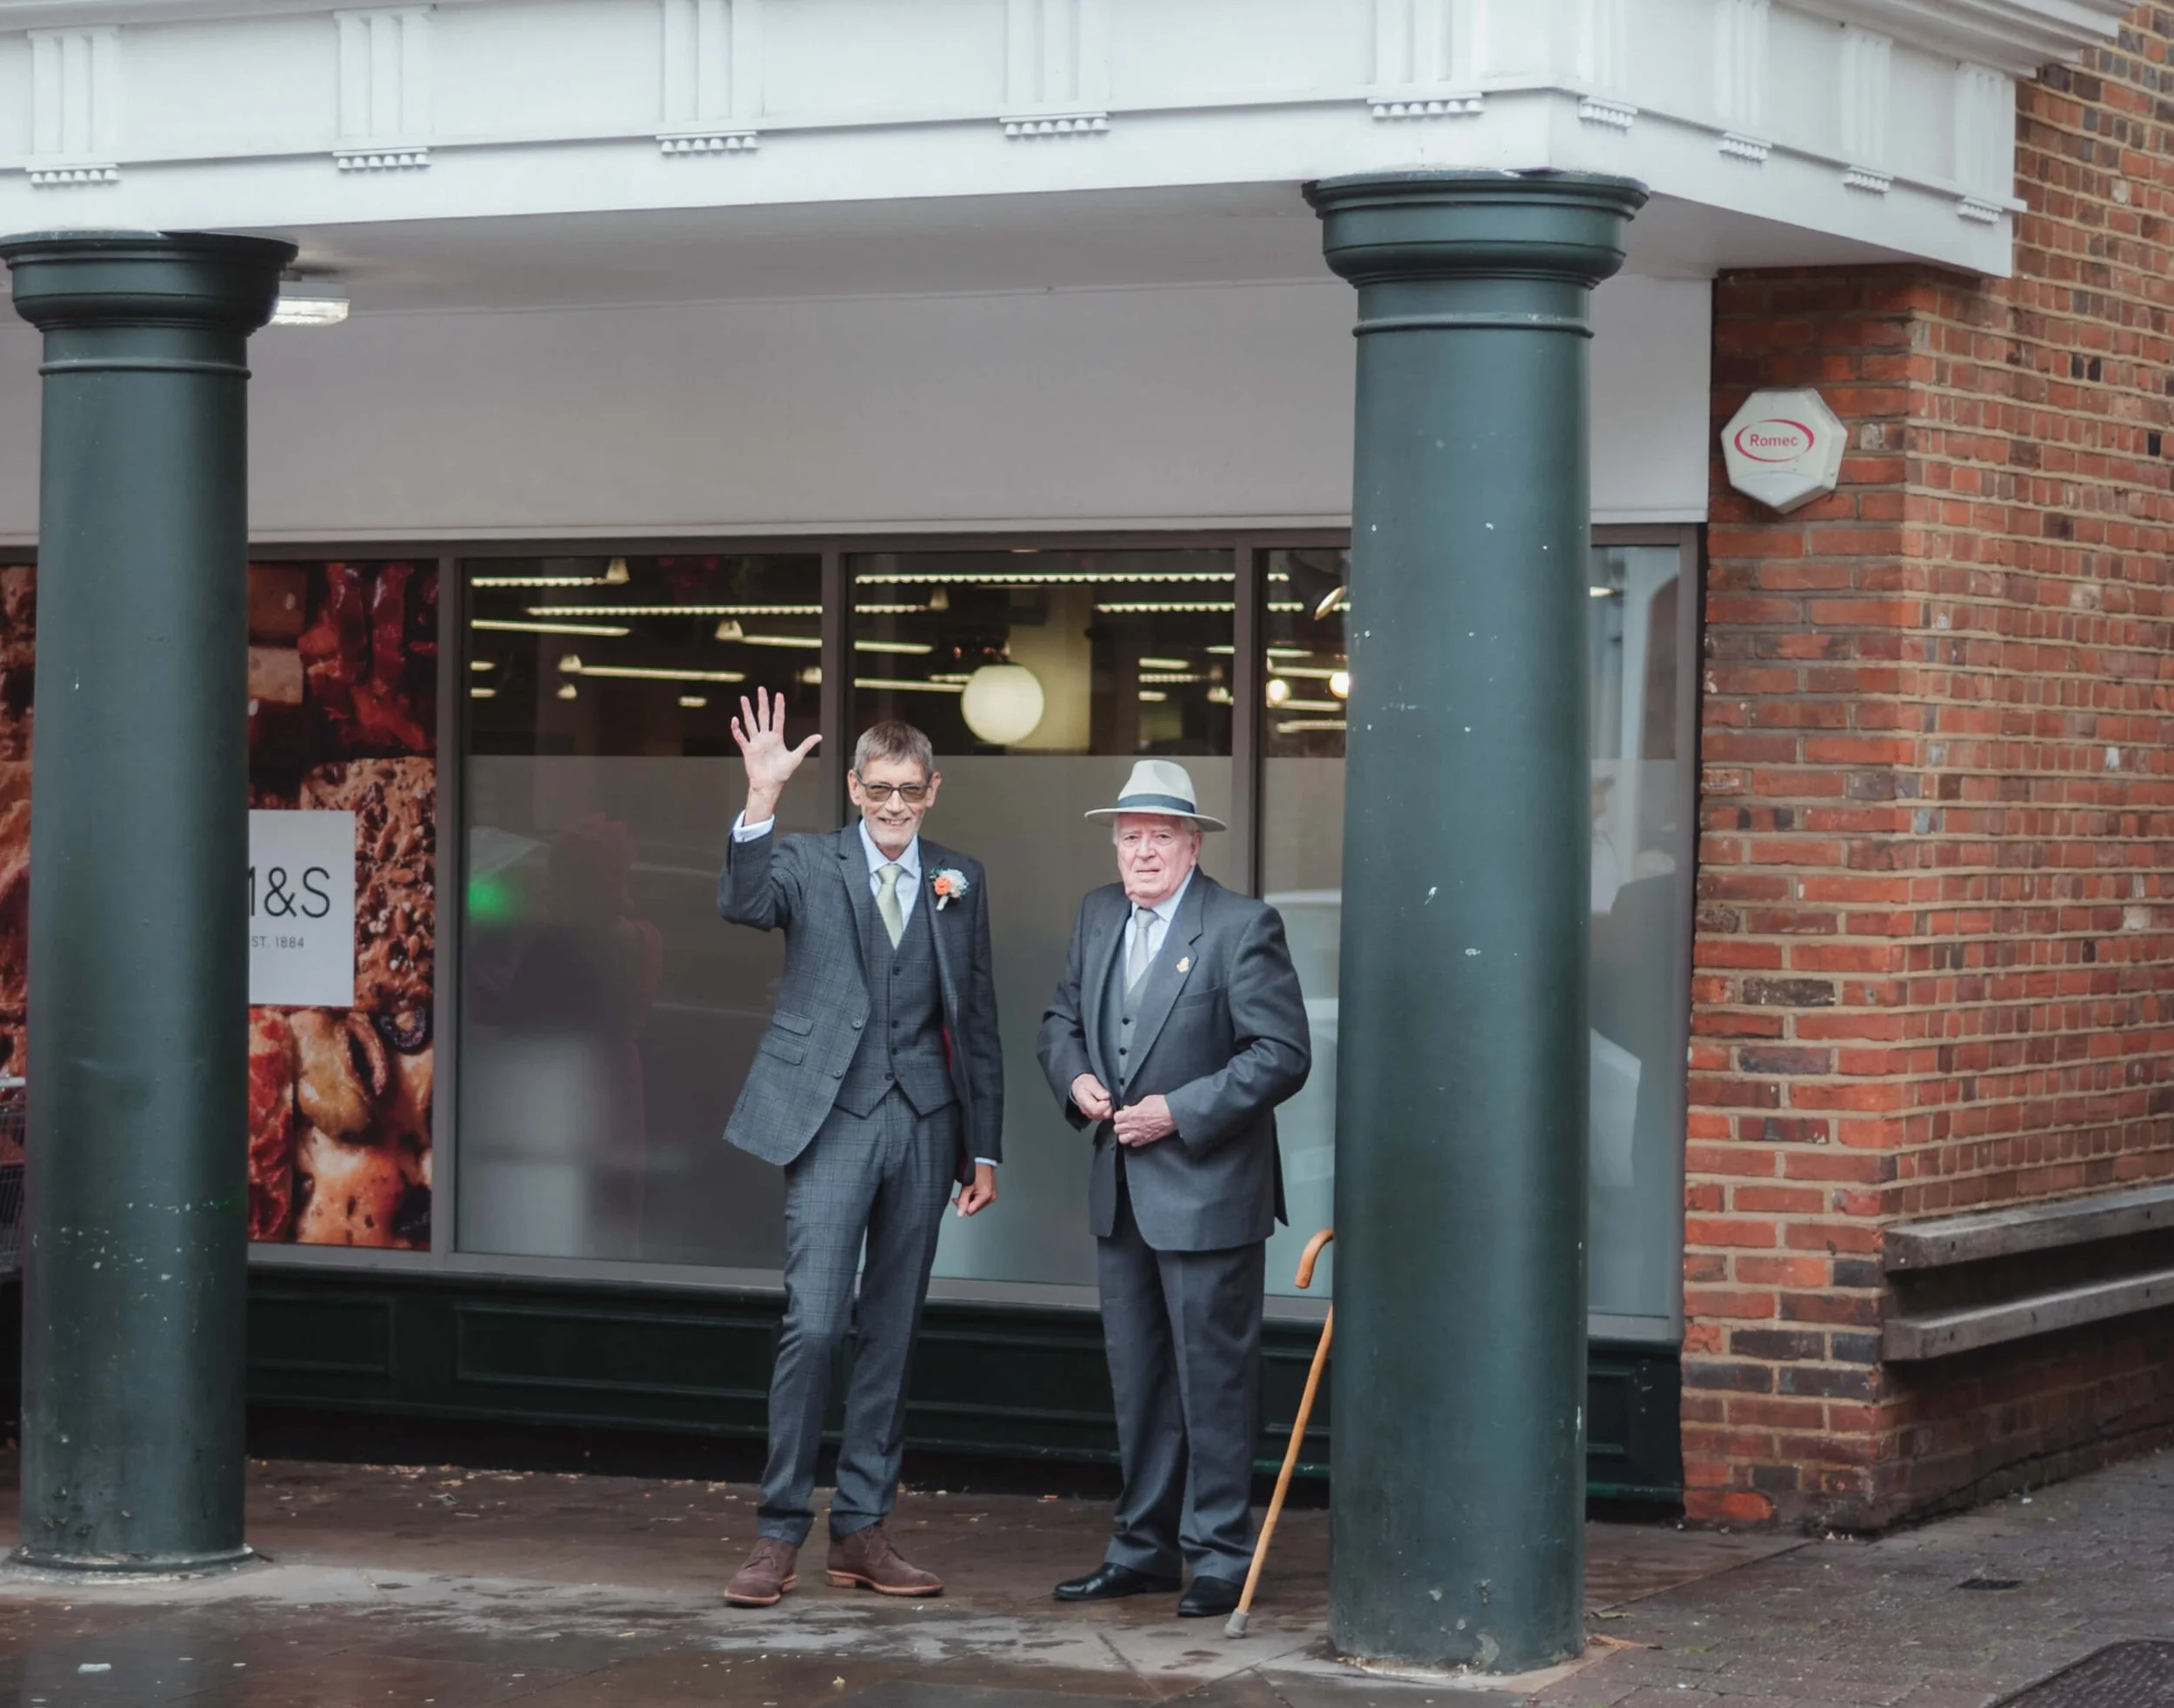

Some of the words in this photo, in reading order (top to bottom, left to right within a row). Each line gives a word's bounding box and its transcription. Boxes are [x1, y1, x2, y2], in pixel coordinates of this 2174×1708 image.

[1750, 433, 1798, 447] Romec
[249, 865, 330, 918] &S
[251, 936, 270, 948] ST.
[276, 936, 304, 948] 1884
